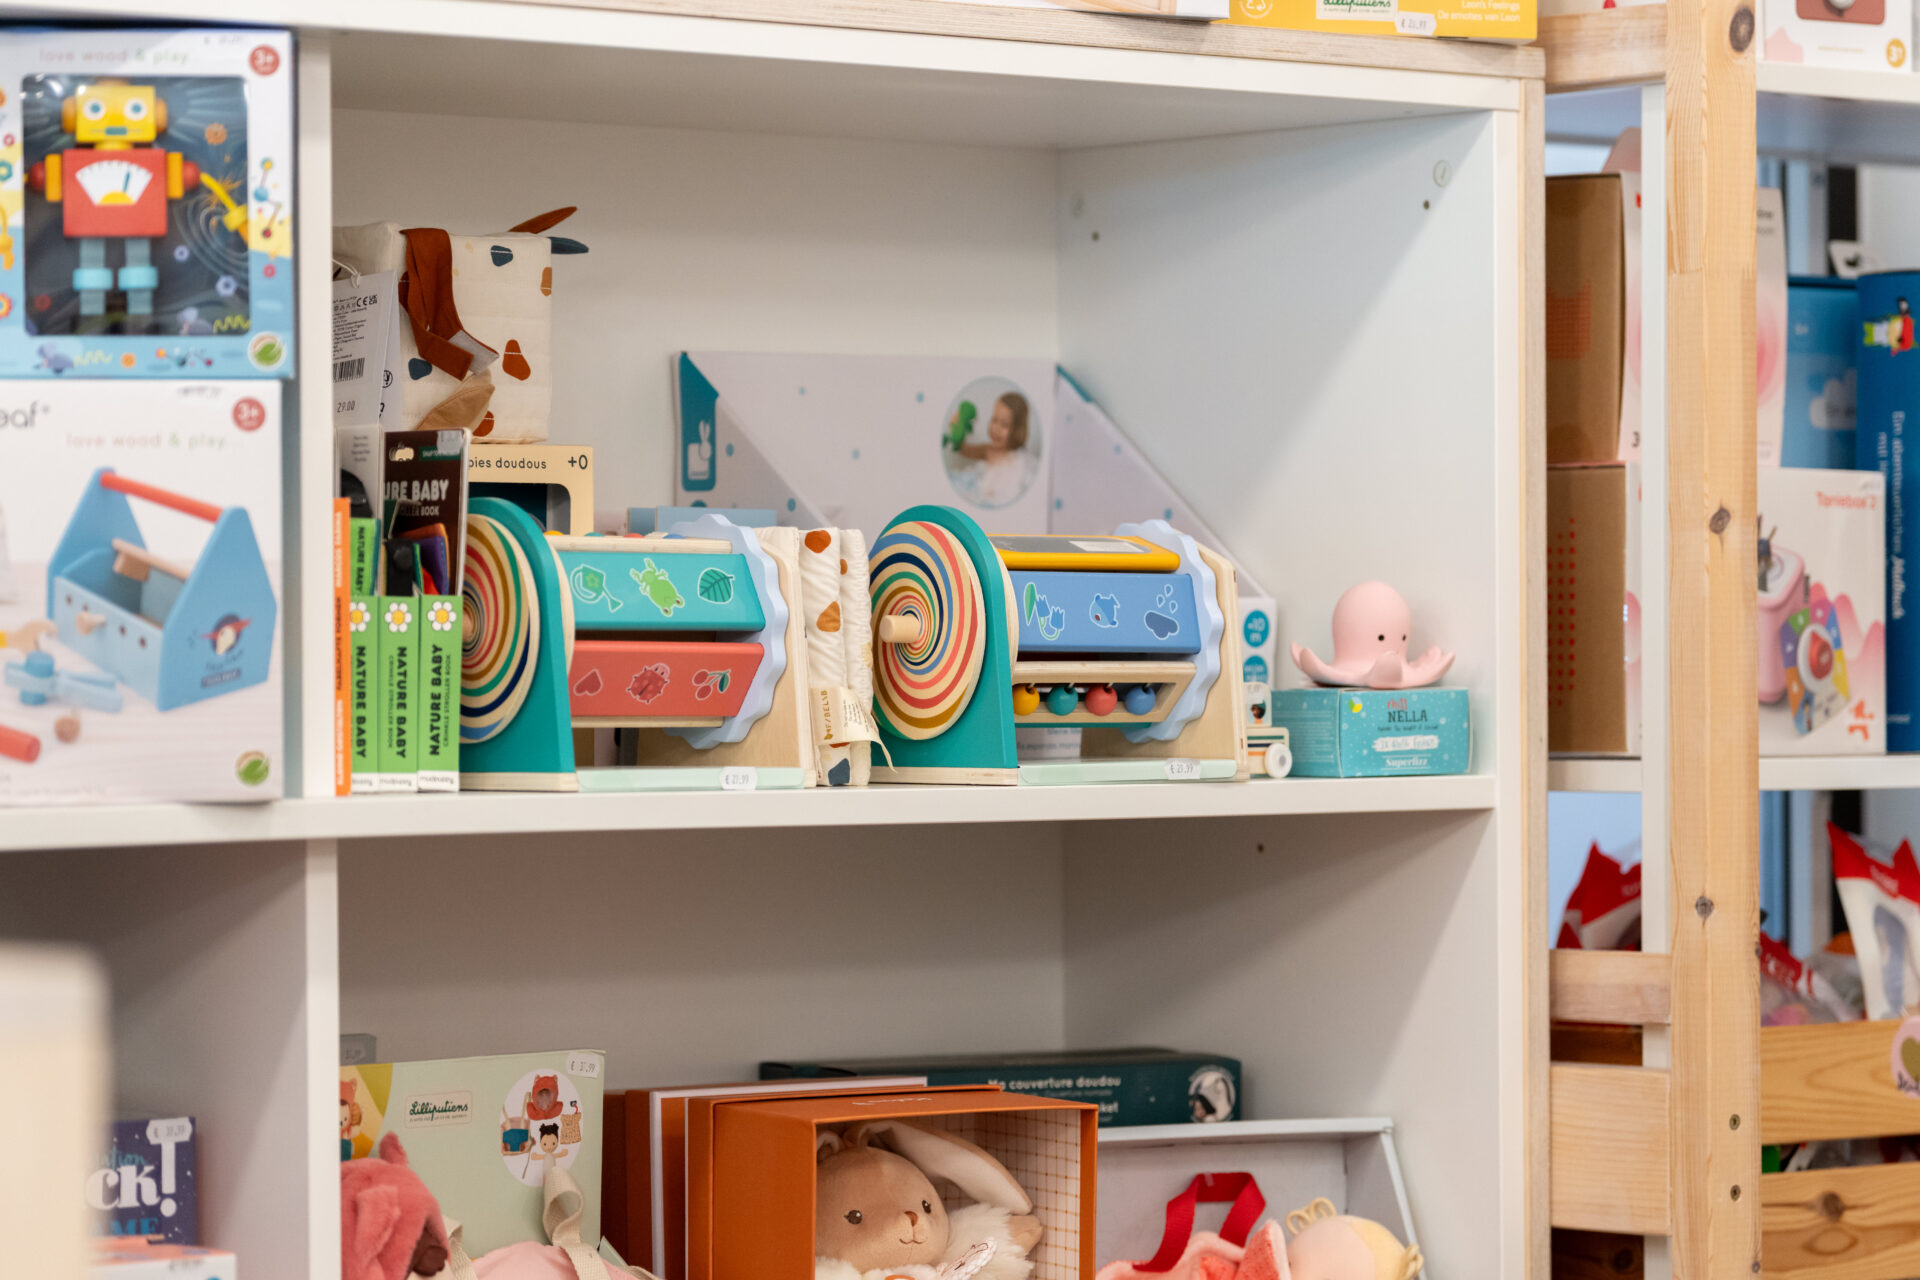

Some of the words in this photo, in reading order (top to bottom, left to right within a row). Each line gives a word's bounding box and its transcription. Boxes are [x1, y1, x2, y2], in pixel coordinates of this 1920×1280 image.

[495, 457, 547, 470] doudous
[356, 645, 367, 710] NATURE
[396, 646, 408, 710] NATURE
[431, 644, 443, 687] BABY
[429, 692, 442, 756] NATURE
[1388, 708, 1428, 723] NELLA
[356, 716, 366, 759] BABY
[396, 716, 407, 759] BABY
[1009, 1077, 1074, 1090] couverture
[1075, 1076, 1122, 1088] doudou
[409, 1100, 469, 1121] Lilliputiens
